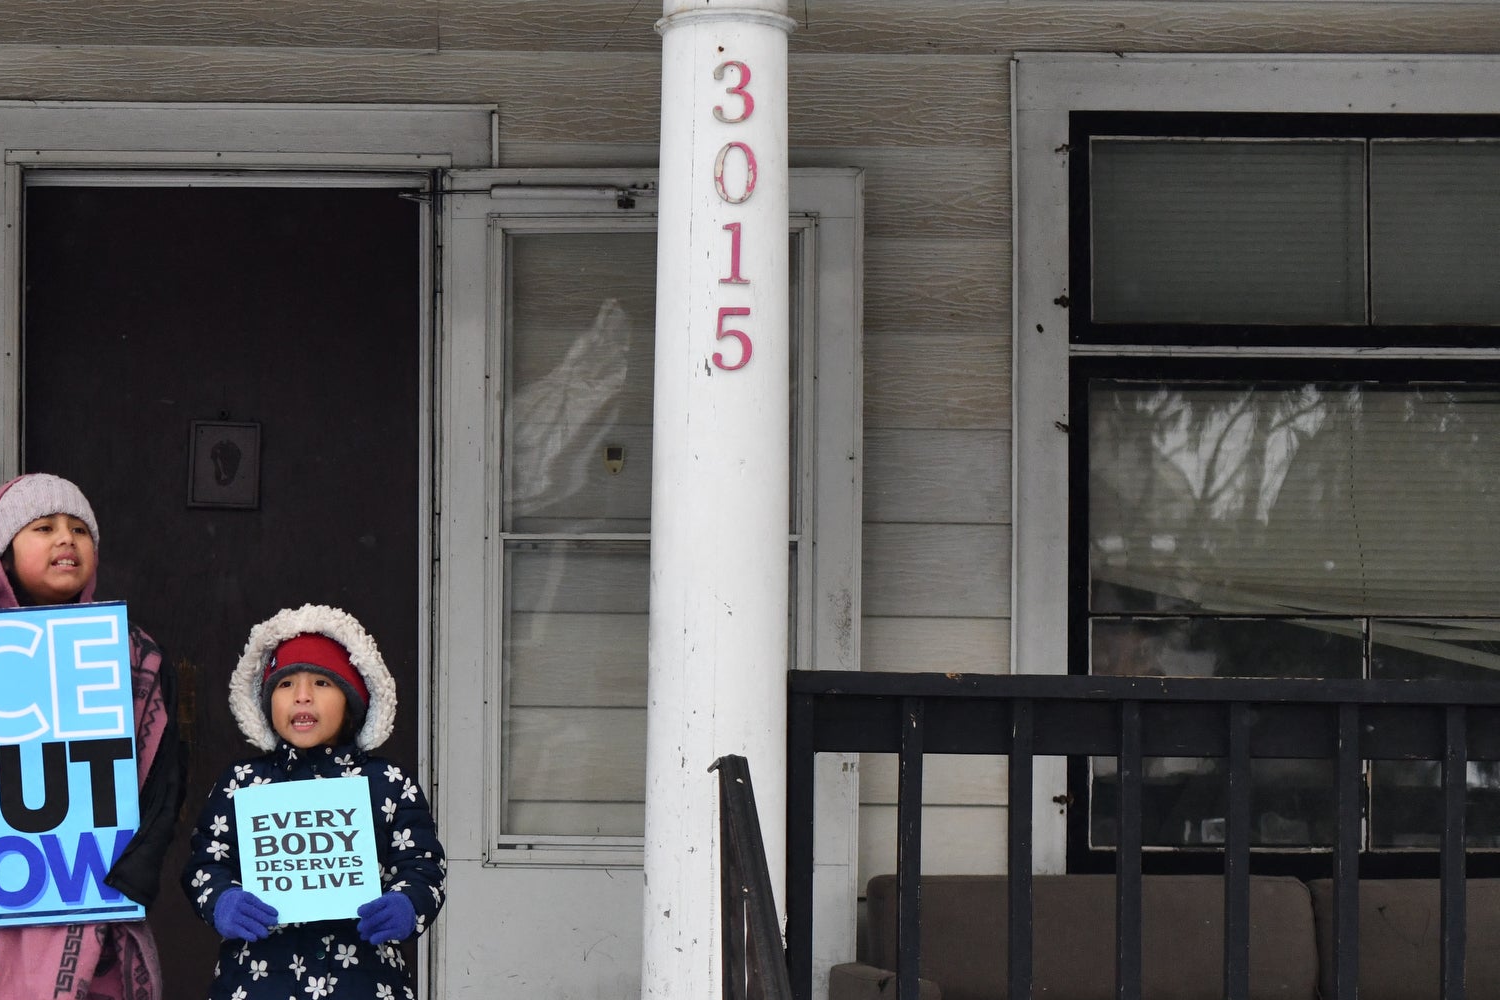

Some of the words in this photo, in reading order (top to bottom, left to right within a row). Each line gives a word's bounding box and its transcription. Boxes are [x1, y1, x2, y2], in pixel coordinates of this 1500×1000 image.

[712, 60, 757, 371] 3015
[251, 808, 357, 832] EVERY
[252, 830, 360, 857] BODY
[255, 856, 363, 872] DESERVES
[257, 876, 293, 891] TO
[301, 872, 364, 890] LIVE
